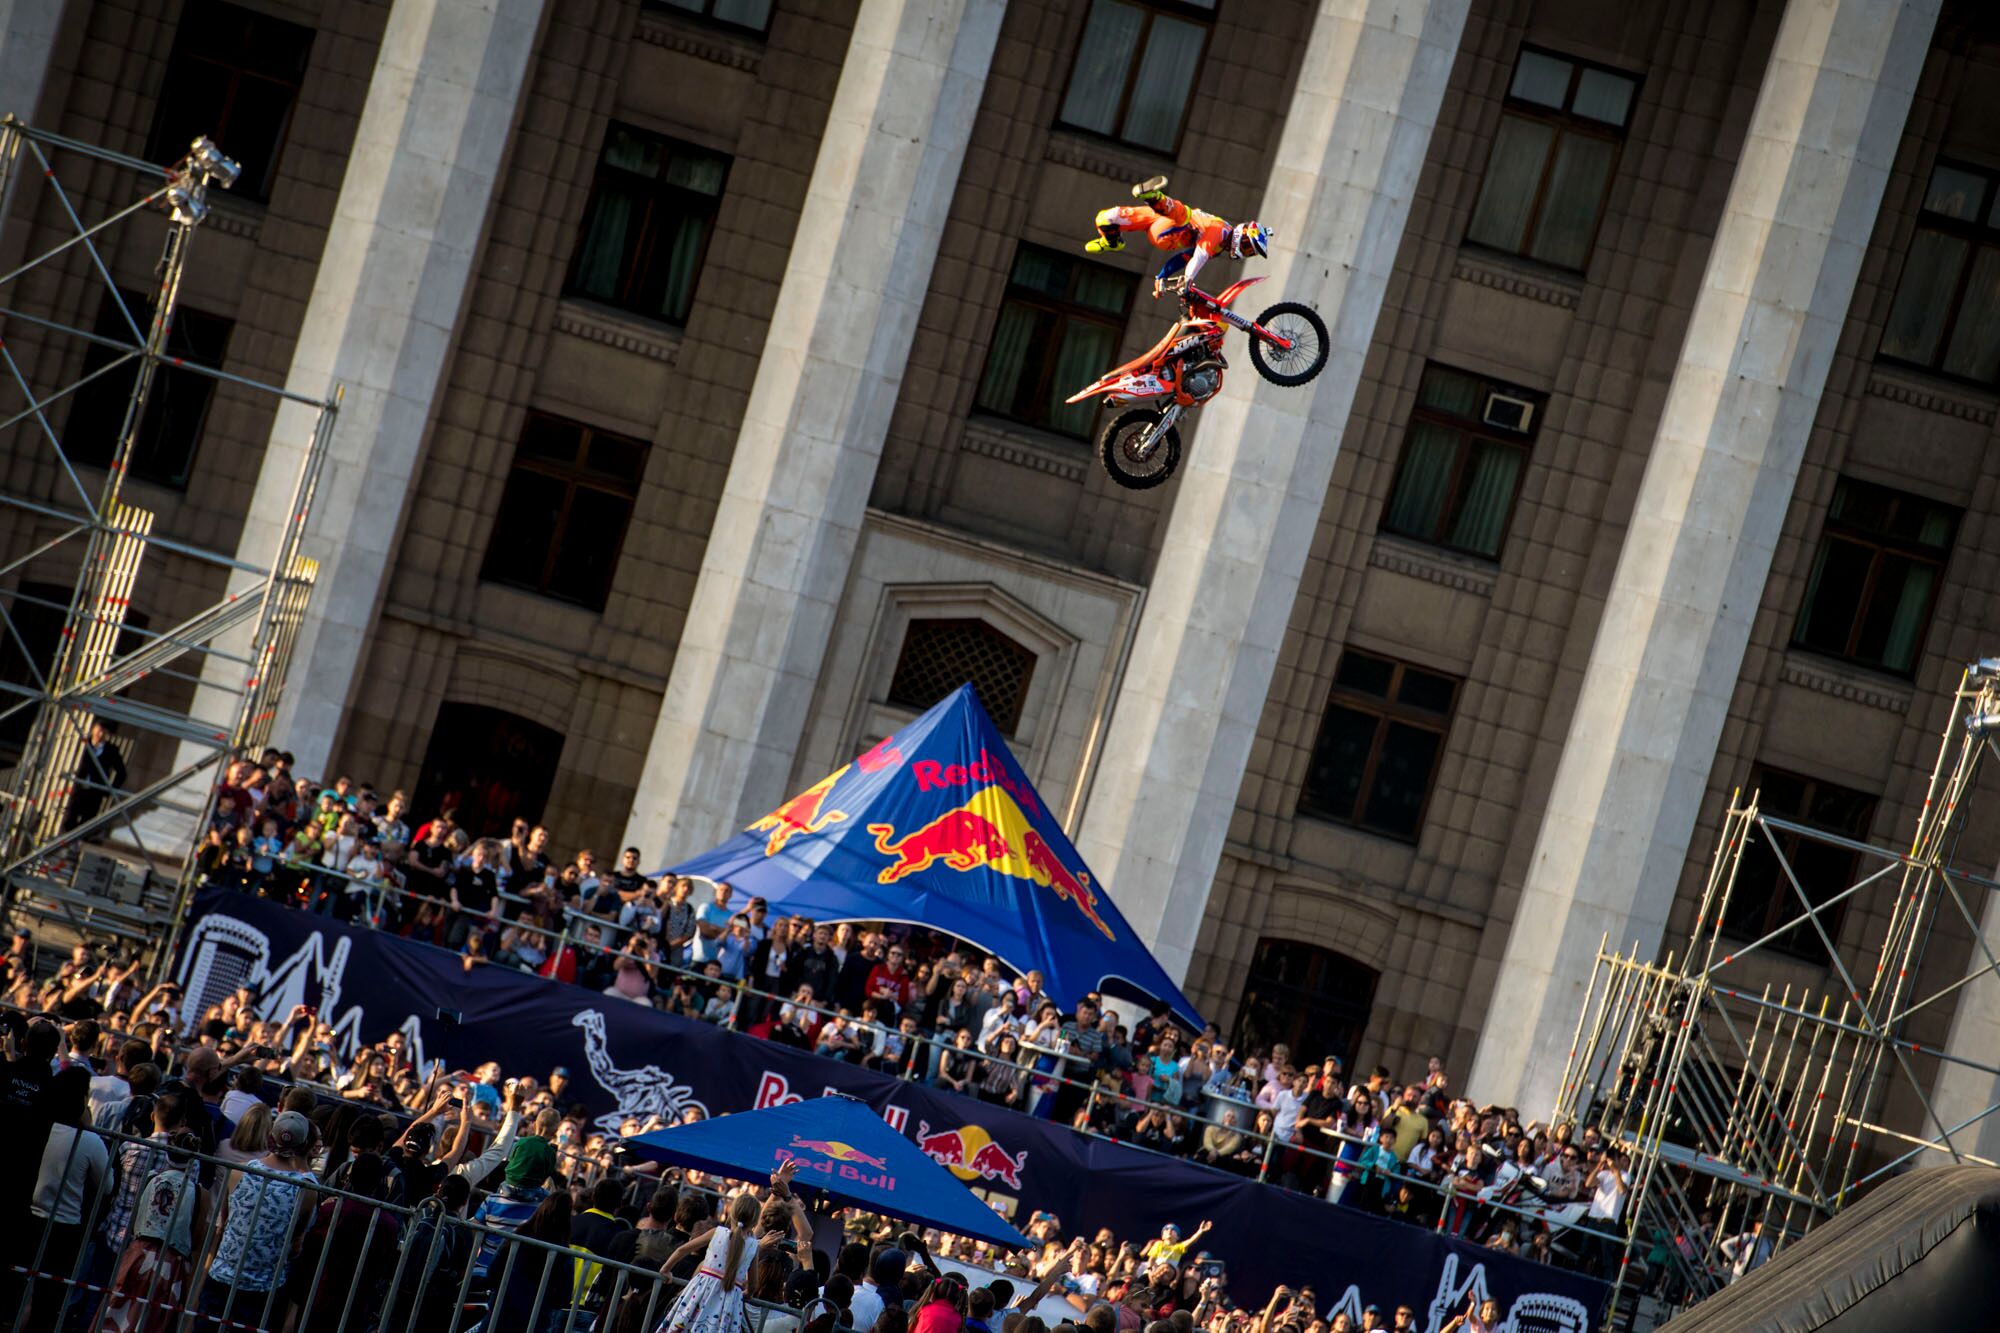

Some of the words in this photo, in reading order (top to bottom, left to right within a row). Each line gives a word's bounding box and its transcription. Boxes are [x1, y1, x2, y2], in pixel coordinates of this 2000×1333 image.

[912, 748, 995, 792] Red
[774, 1148, 834, 1174] Red
[839, 1164, 896, 1191] Bull
